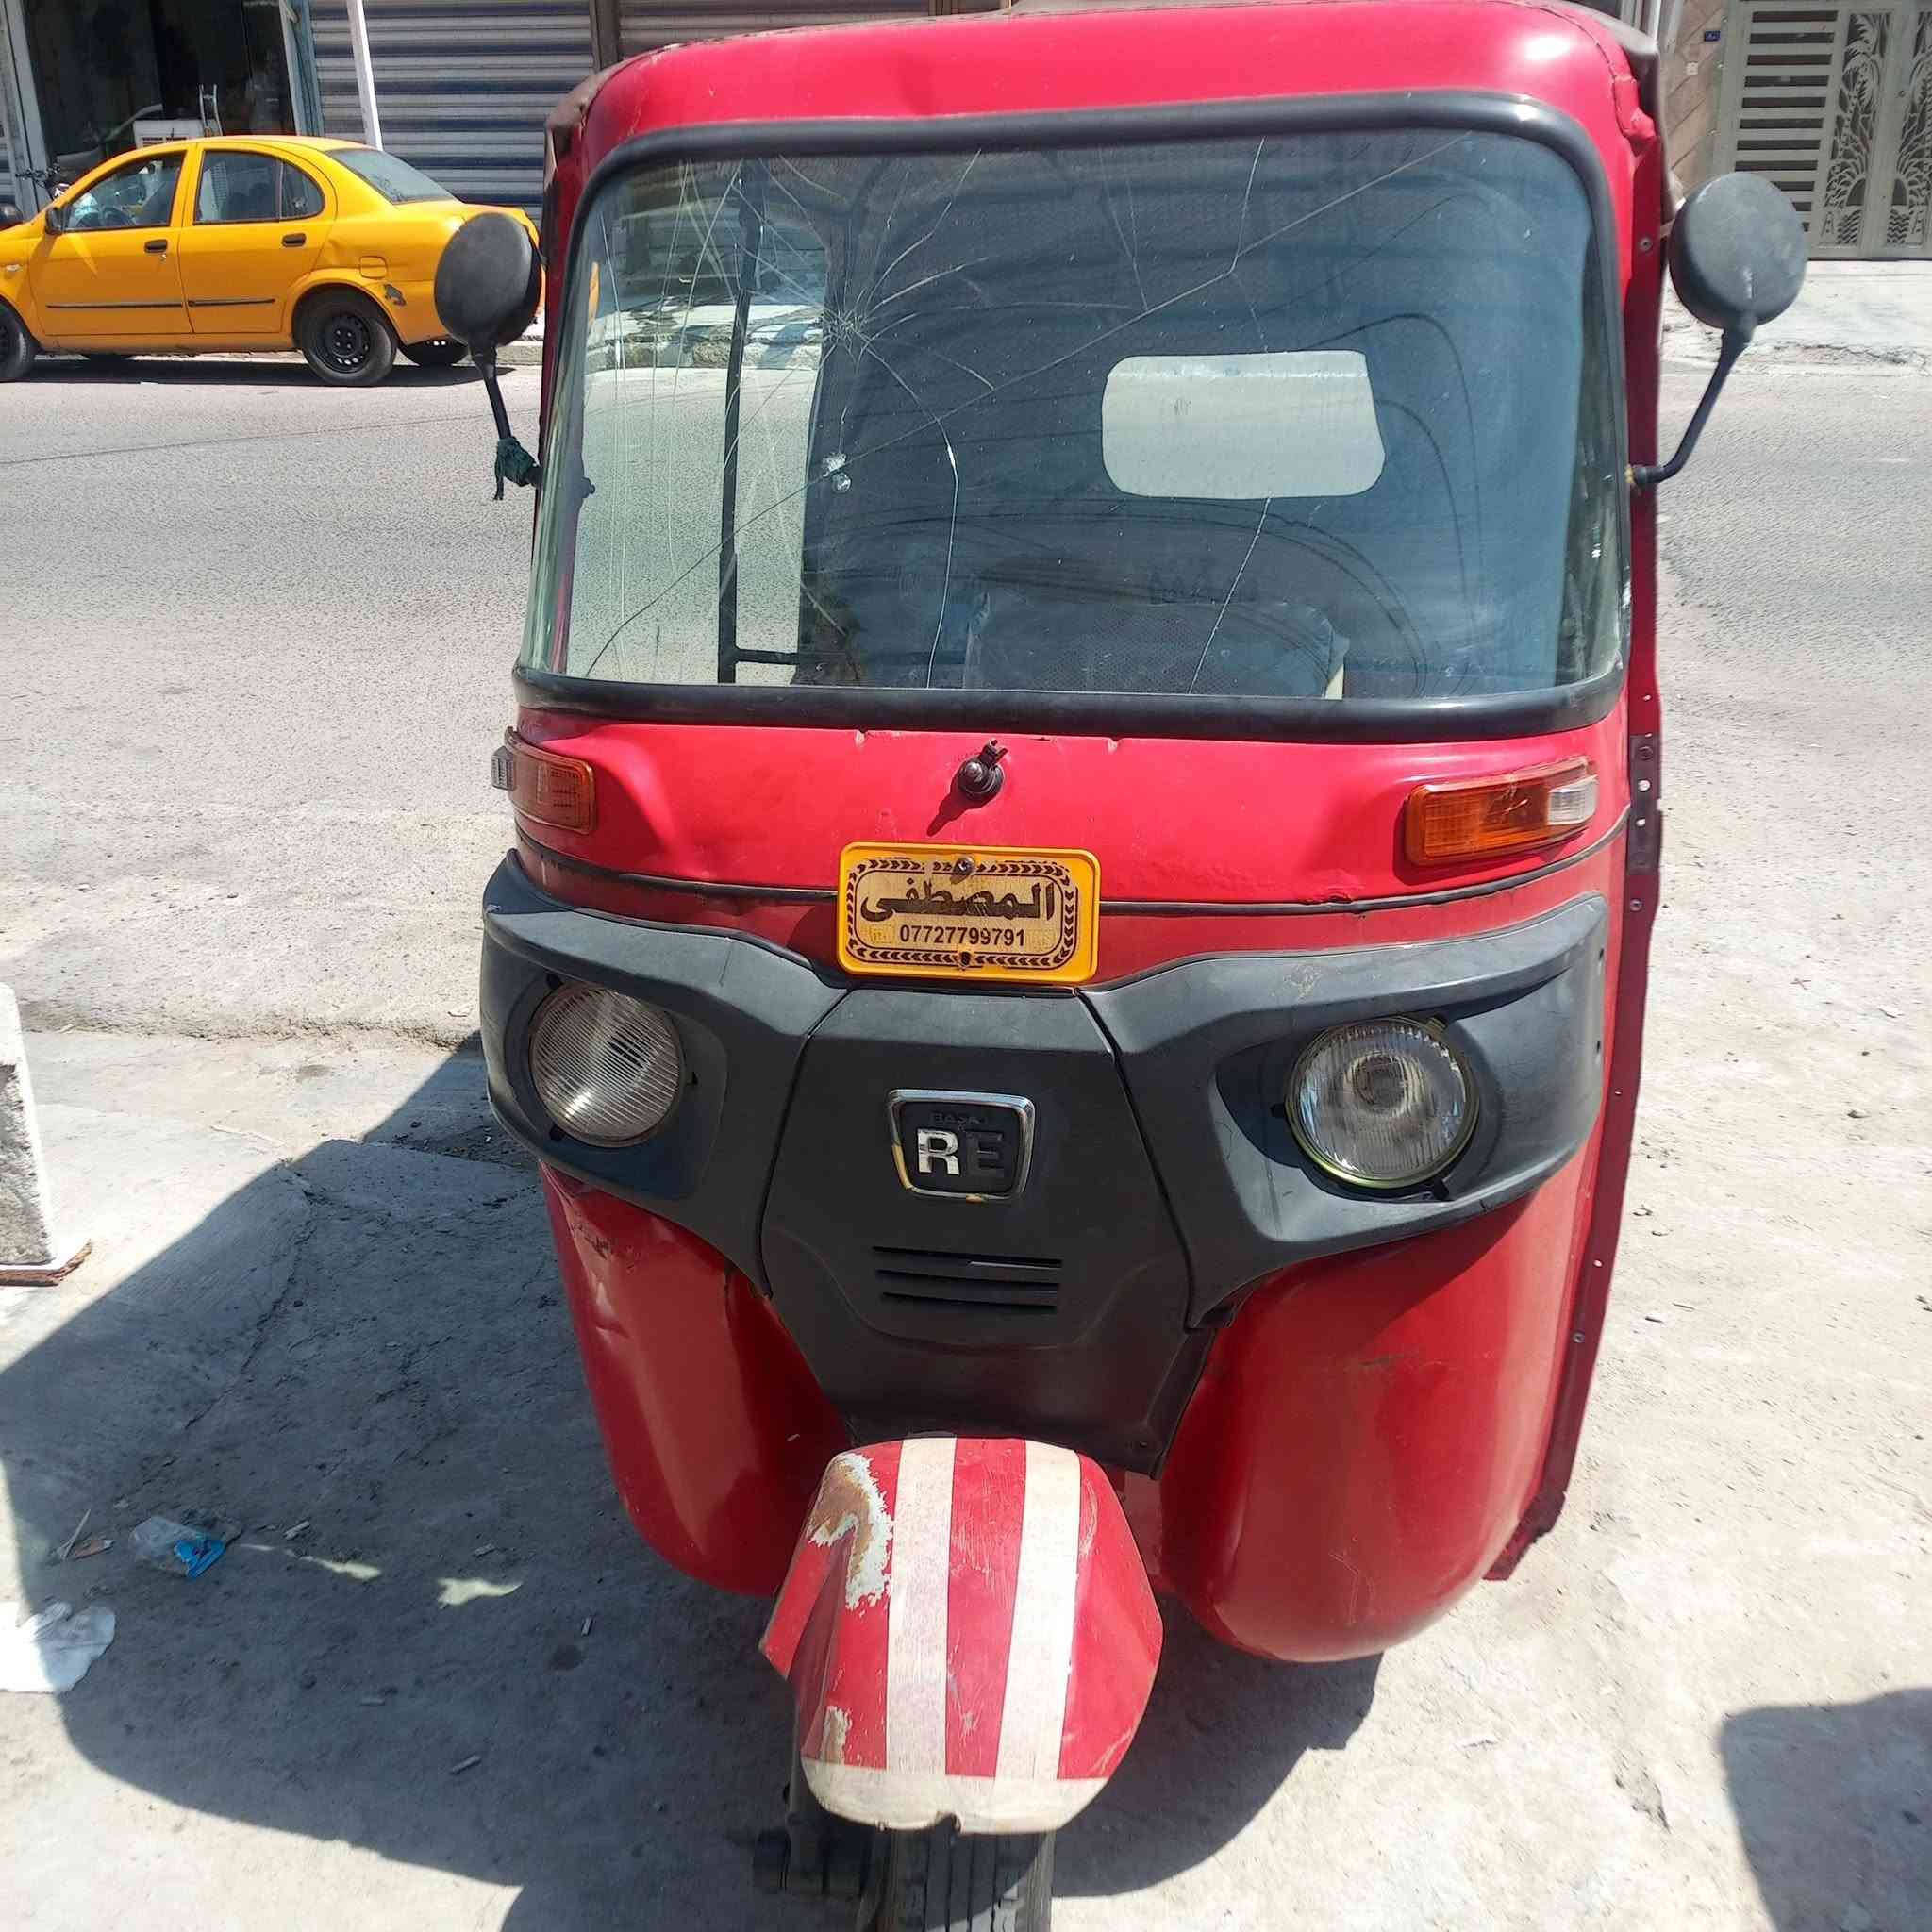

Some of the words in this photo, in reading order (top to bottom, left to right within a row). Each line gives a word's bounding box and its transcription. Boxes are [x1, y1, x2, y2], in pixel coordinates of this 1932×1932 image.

[859, 878, 1055, 922] المصطفى
[899, 924, 1025, 946] 07727799791
[917, 1128, 1005, 1178] RE
